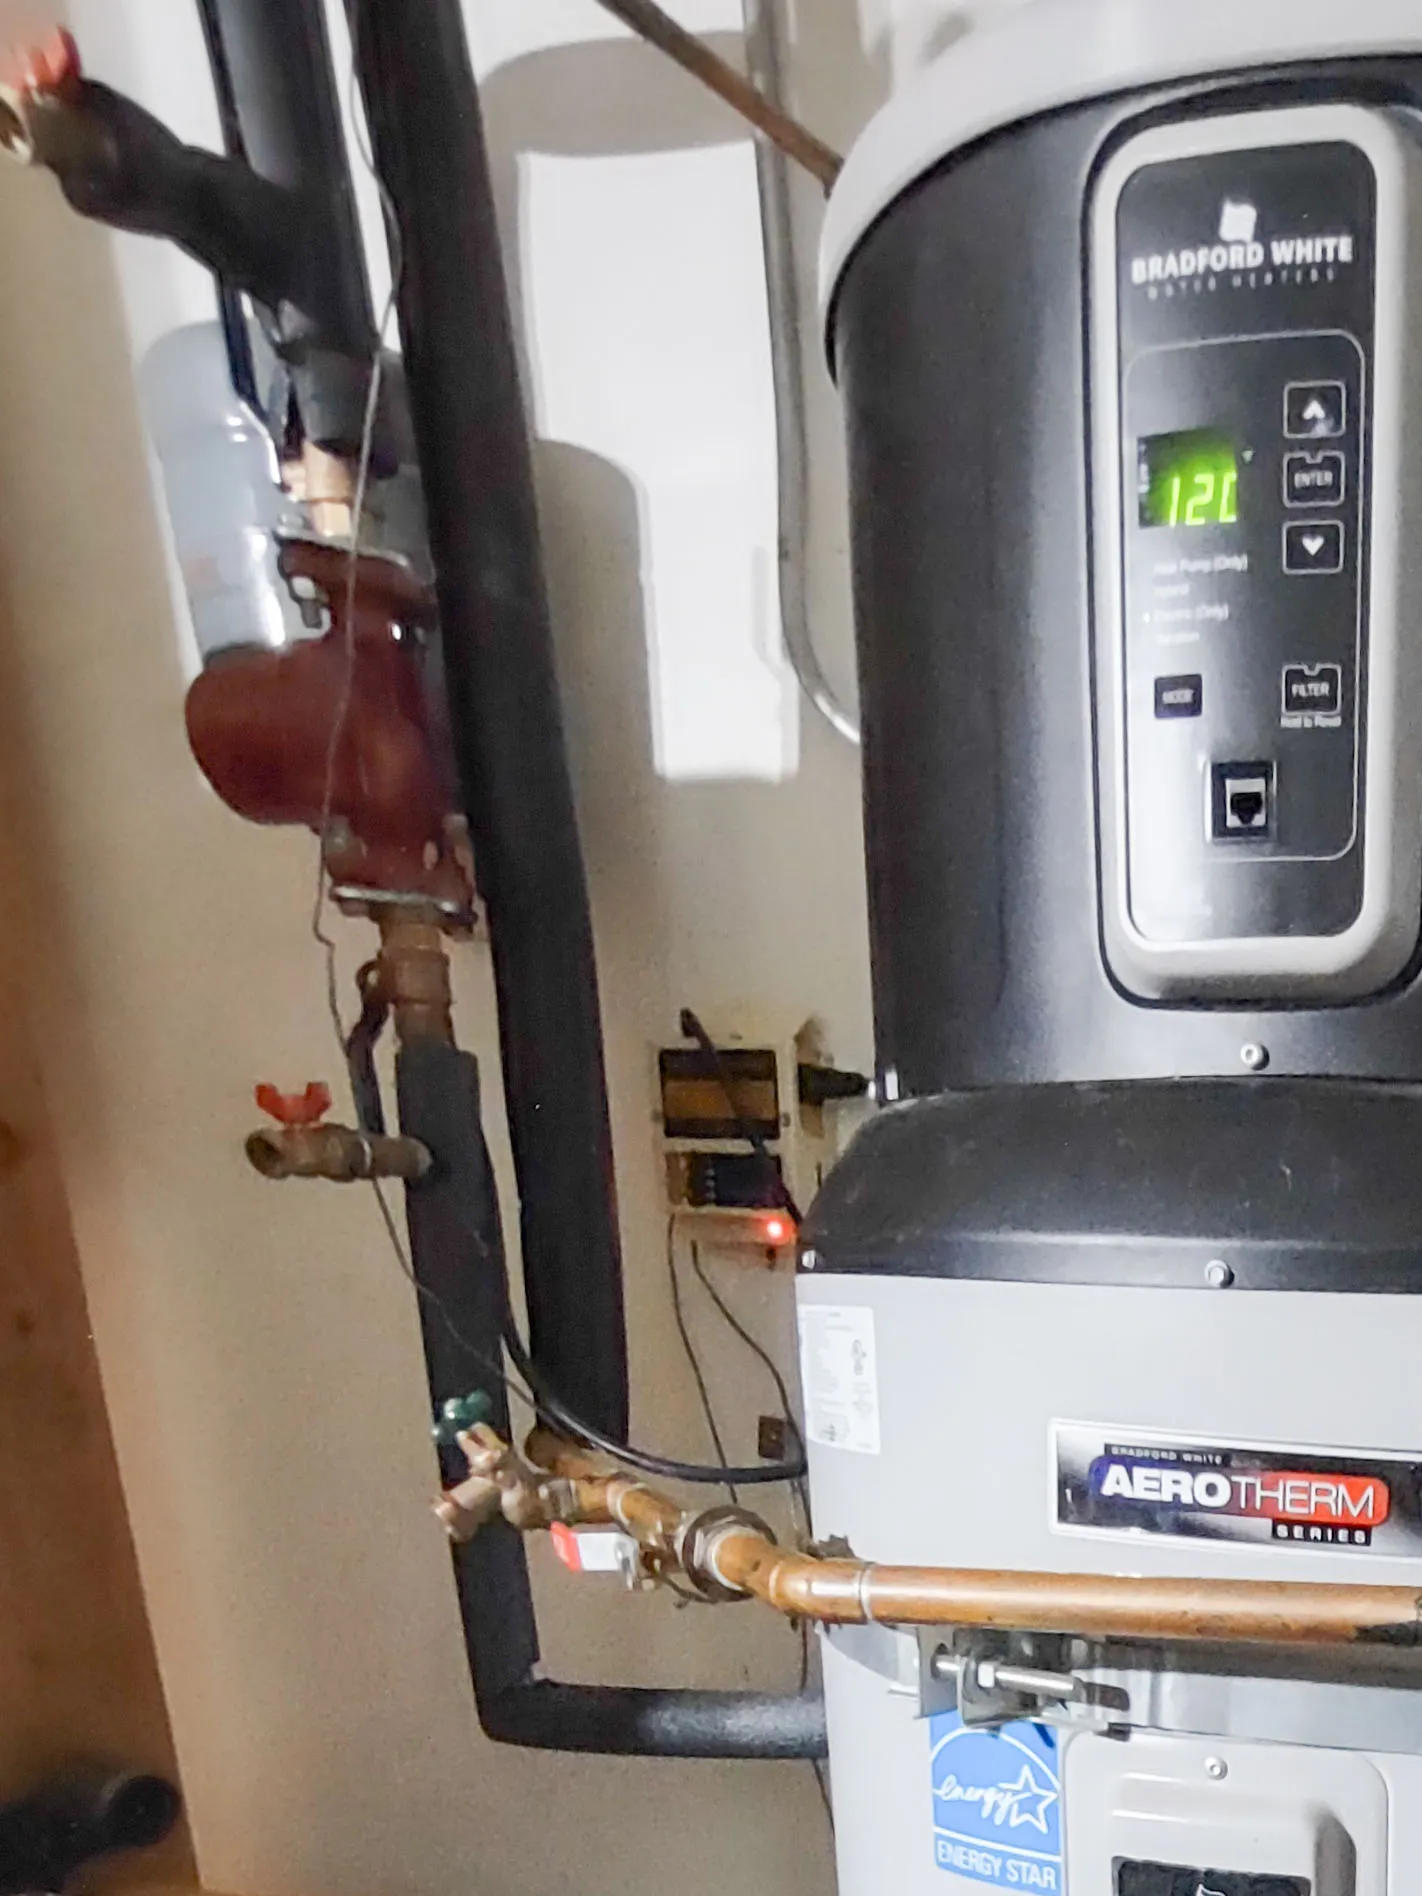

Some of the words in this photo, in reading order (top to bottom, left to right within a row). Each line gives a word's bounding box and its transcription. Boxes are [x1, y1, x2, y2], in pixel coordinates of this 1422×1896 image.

[1131, 240, 1265, 284] BRADFORD
[1270, 234, 1353, 265] WHITE
[1294, 470, 1334, 489] ENTER
[1292, 680, 1331, 699] FILTER
[1111, 1446, 1178, 1461] BRADFORD
[1182, 1452, 1223, 1465] WHITE
[1101, 1463, 1374, 1520] AEROTHERM
[1276, 1523, 1367, 1545] SERIES
[937, 1840, 1002, 1878] ENERGY
[1006, 1858, 1057, 1890] STAR
